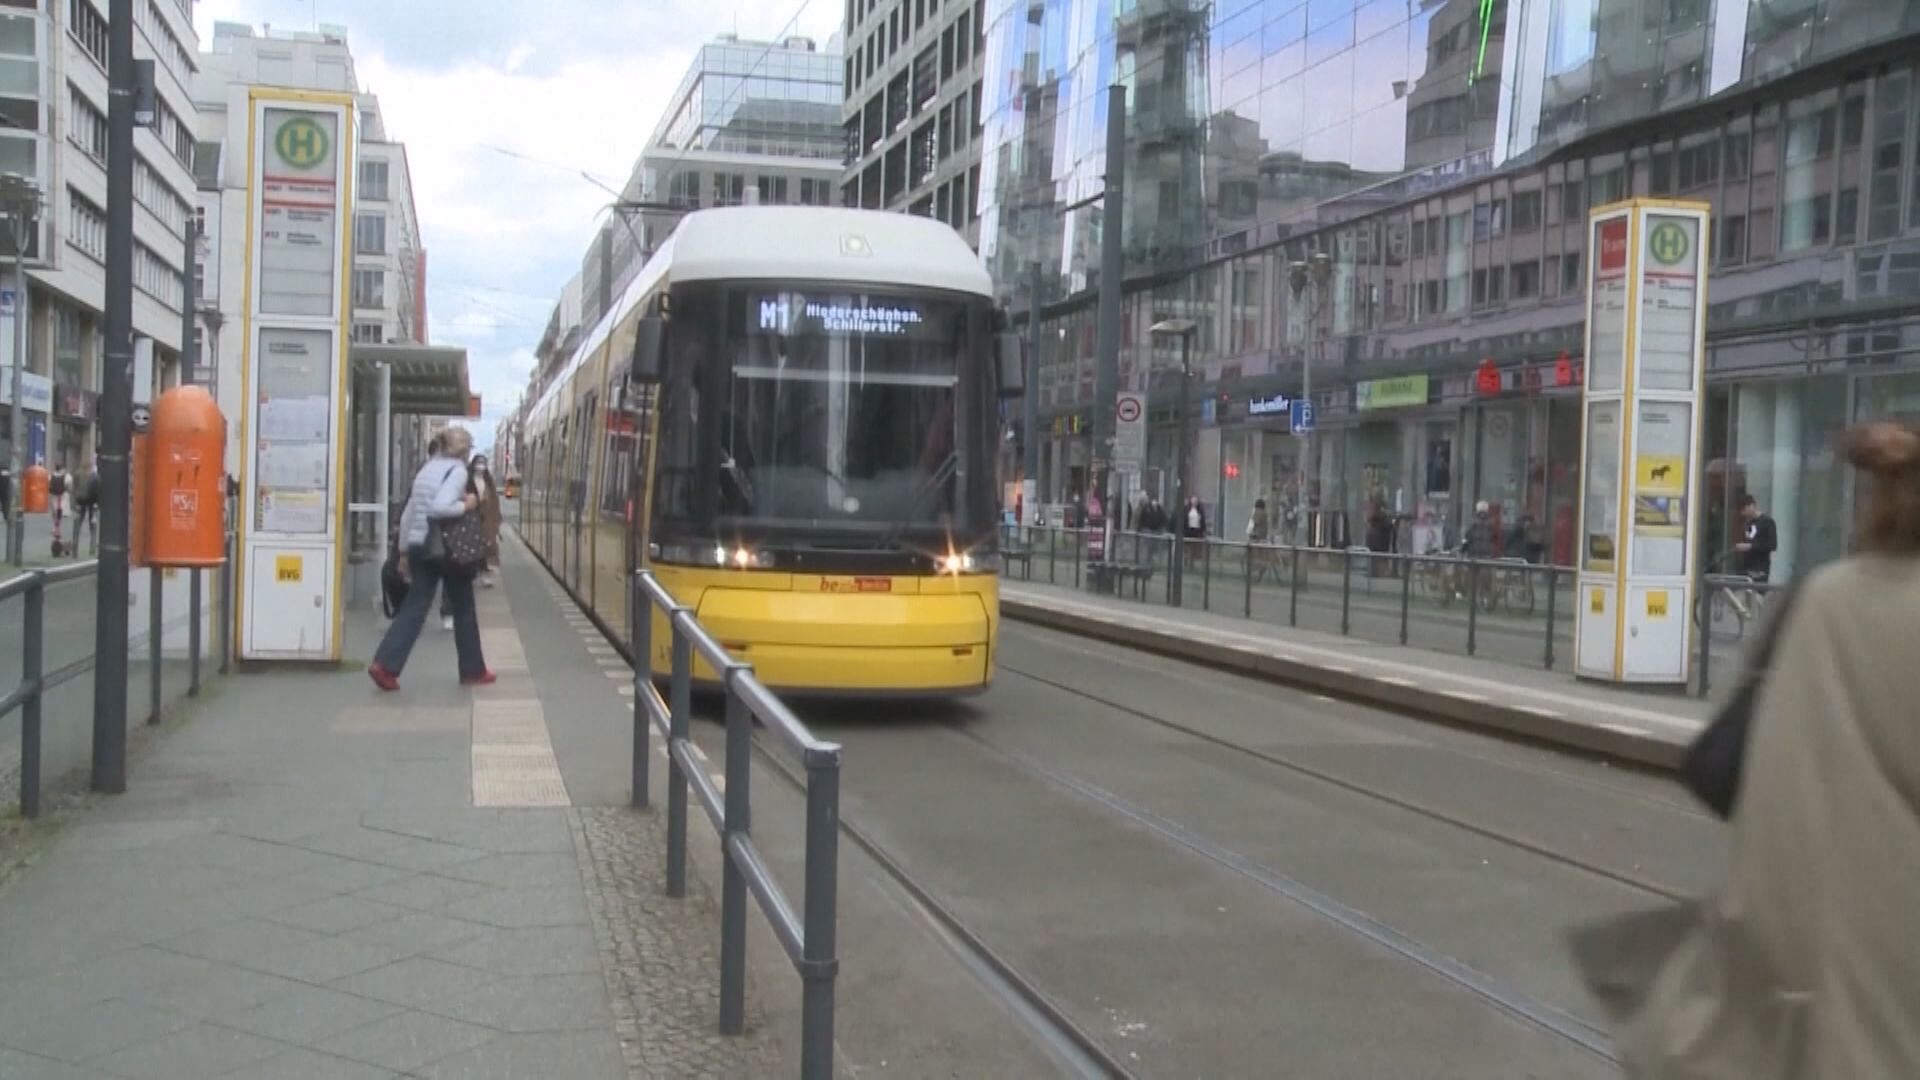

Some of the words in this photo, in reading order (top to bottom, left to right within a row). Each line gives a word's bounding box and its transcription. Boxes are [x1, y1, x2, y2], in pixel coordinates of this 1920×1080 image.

[289, 127, 314, 158] H
[1659, 231, 1679, 256] H
[760, 299, 789, 331] M1
[823, 316, 906, 334] Schillerstr.
[1301, 408, 1313, 429] P
